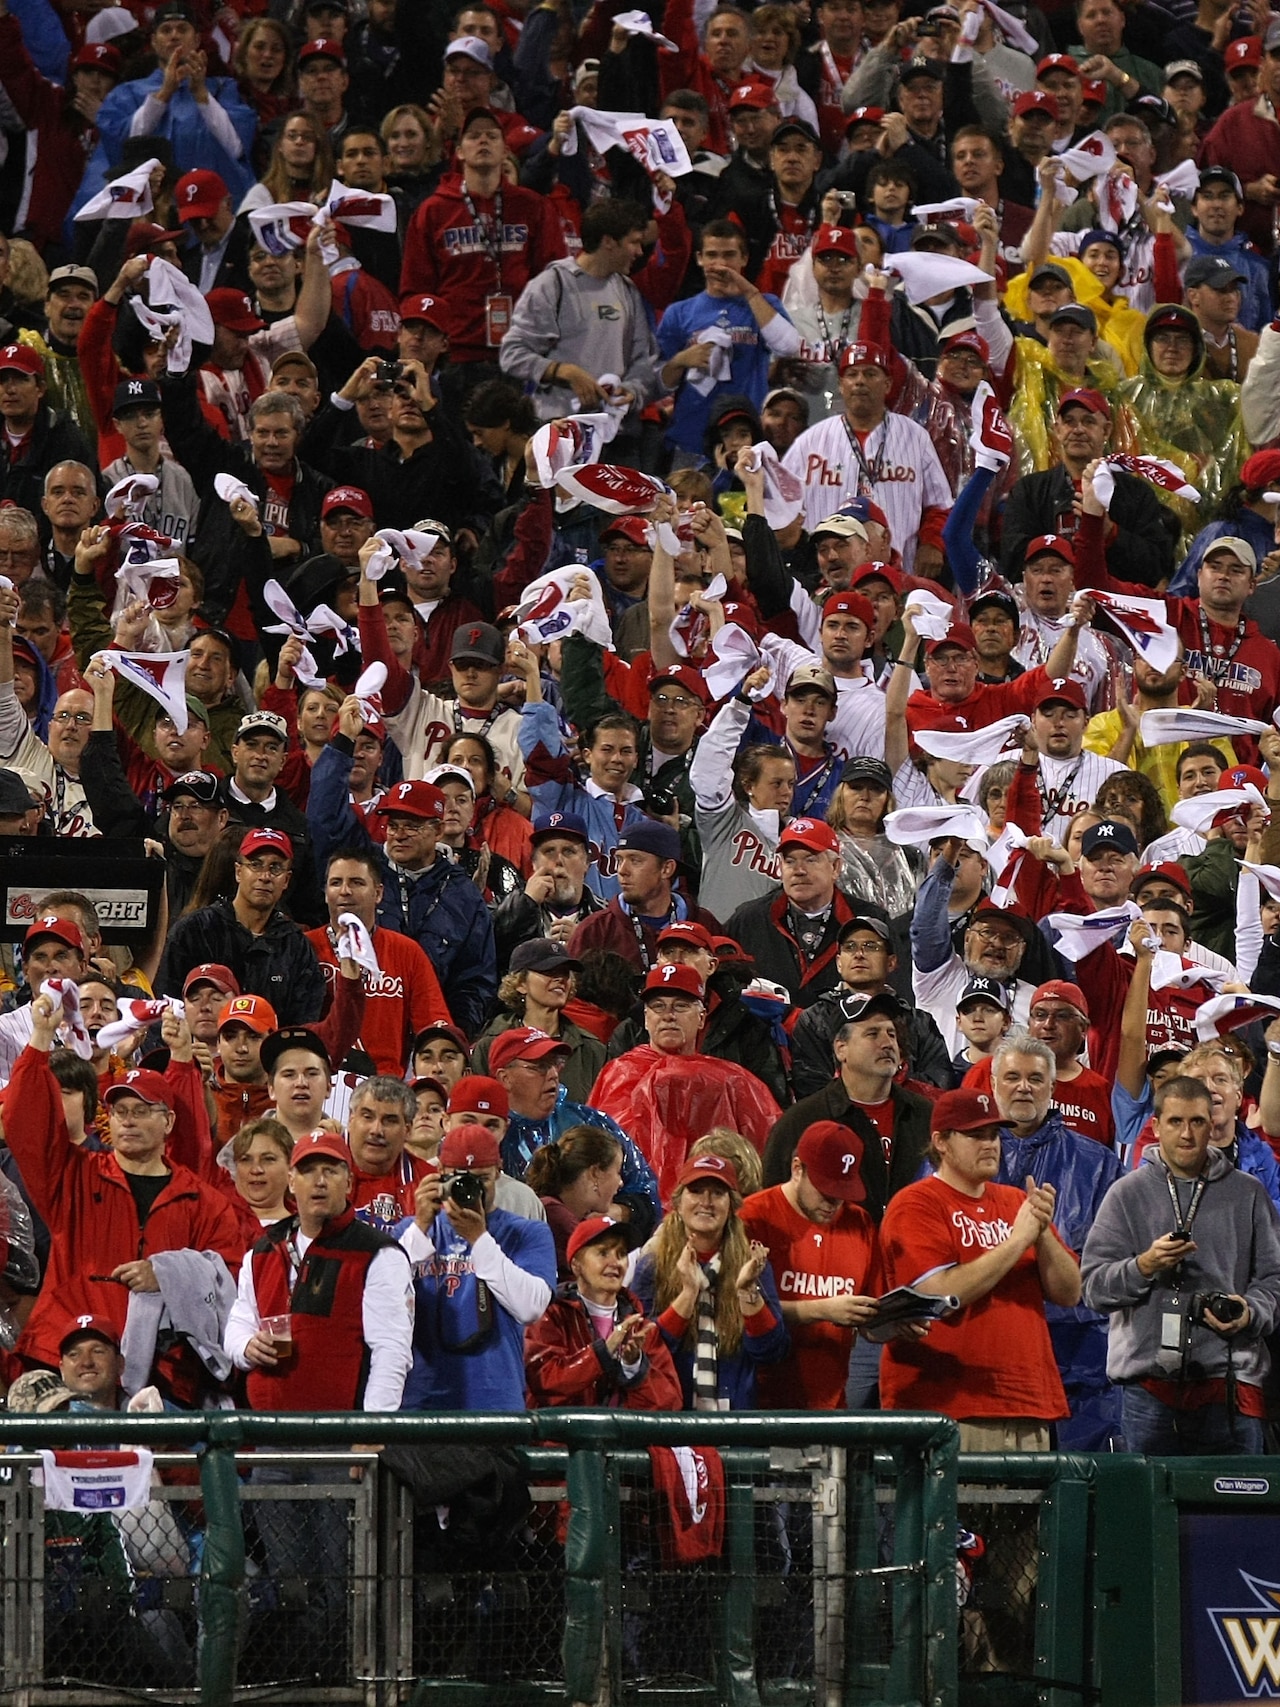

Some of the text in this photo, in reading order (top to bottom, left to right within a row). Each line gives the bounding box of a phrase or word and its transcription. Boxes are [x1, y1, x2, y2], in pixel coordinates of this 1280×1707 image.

[315, 39, 327, 50] P
[1237, 43, 1249, 57] P
[739, 86, 752, 99] P
[1034, 91, 1045, 102] P
[187, 184, 198, 202] P
[830, 230, 843, 243] P
[421, 298, 434, 311] P
[5, 346, 19, 358] P
[128, 381, 143, 396] NY
[1043, 535, 1057, 546] P
[872, 561, 885, 571] P
[725, 603, 738, 616] P
[468, 628, 481, 646] P
[668, 664, 681, 675] P
[1052, 679, 1066, 691] P
[1231, 771, 1247, 786] P
[399, 782, 413, 800] P
[549, 813, 564, 828] P
[1097, 825, 1115, 838] NY
[1150, 860, 1164, 872] P
[43, 916, 58, 929] P
[662, 965, 677, 981] P
[972, 977, 991, 992] NY
[126, 1070, 140, 1084] P
[977, 1095, 991, 1113] P
[310, 1131, 325, 1144] P
[841, 1153, 856, 1174] P
[813, 1234, 823, 1248] P
[446, 1275, 460, 1297] P
[780, 1270, 856, 1298] CHAMPS
[76, 1315, 93, 1329] P
[1219, 1480, 1266, 1492] Van Wagner
